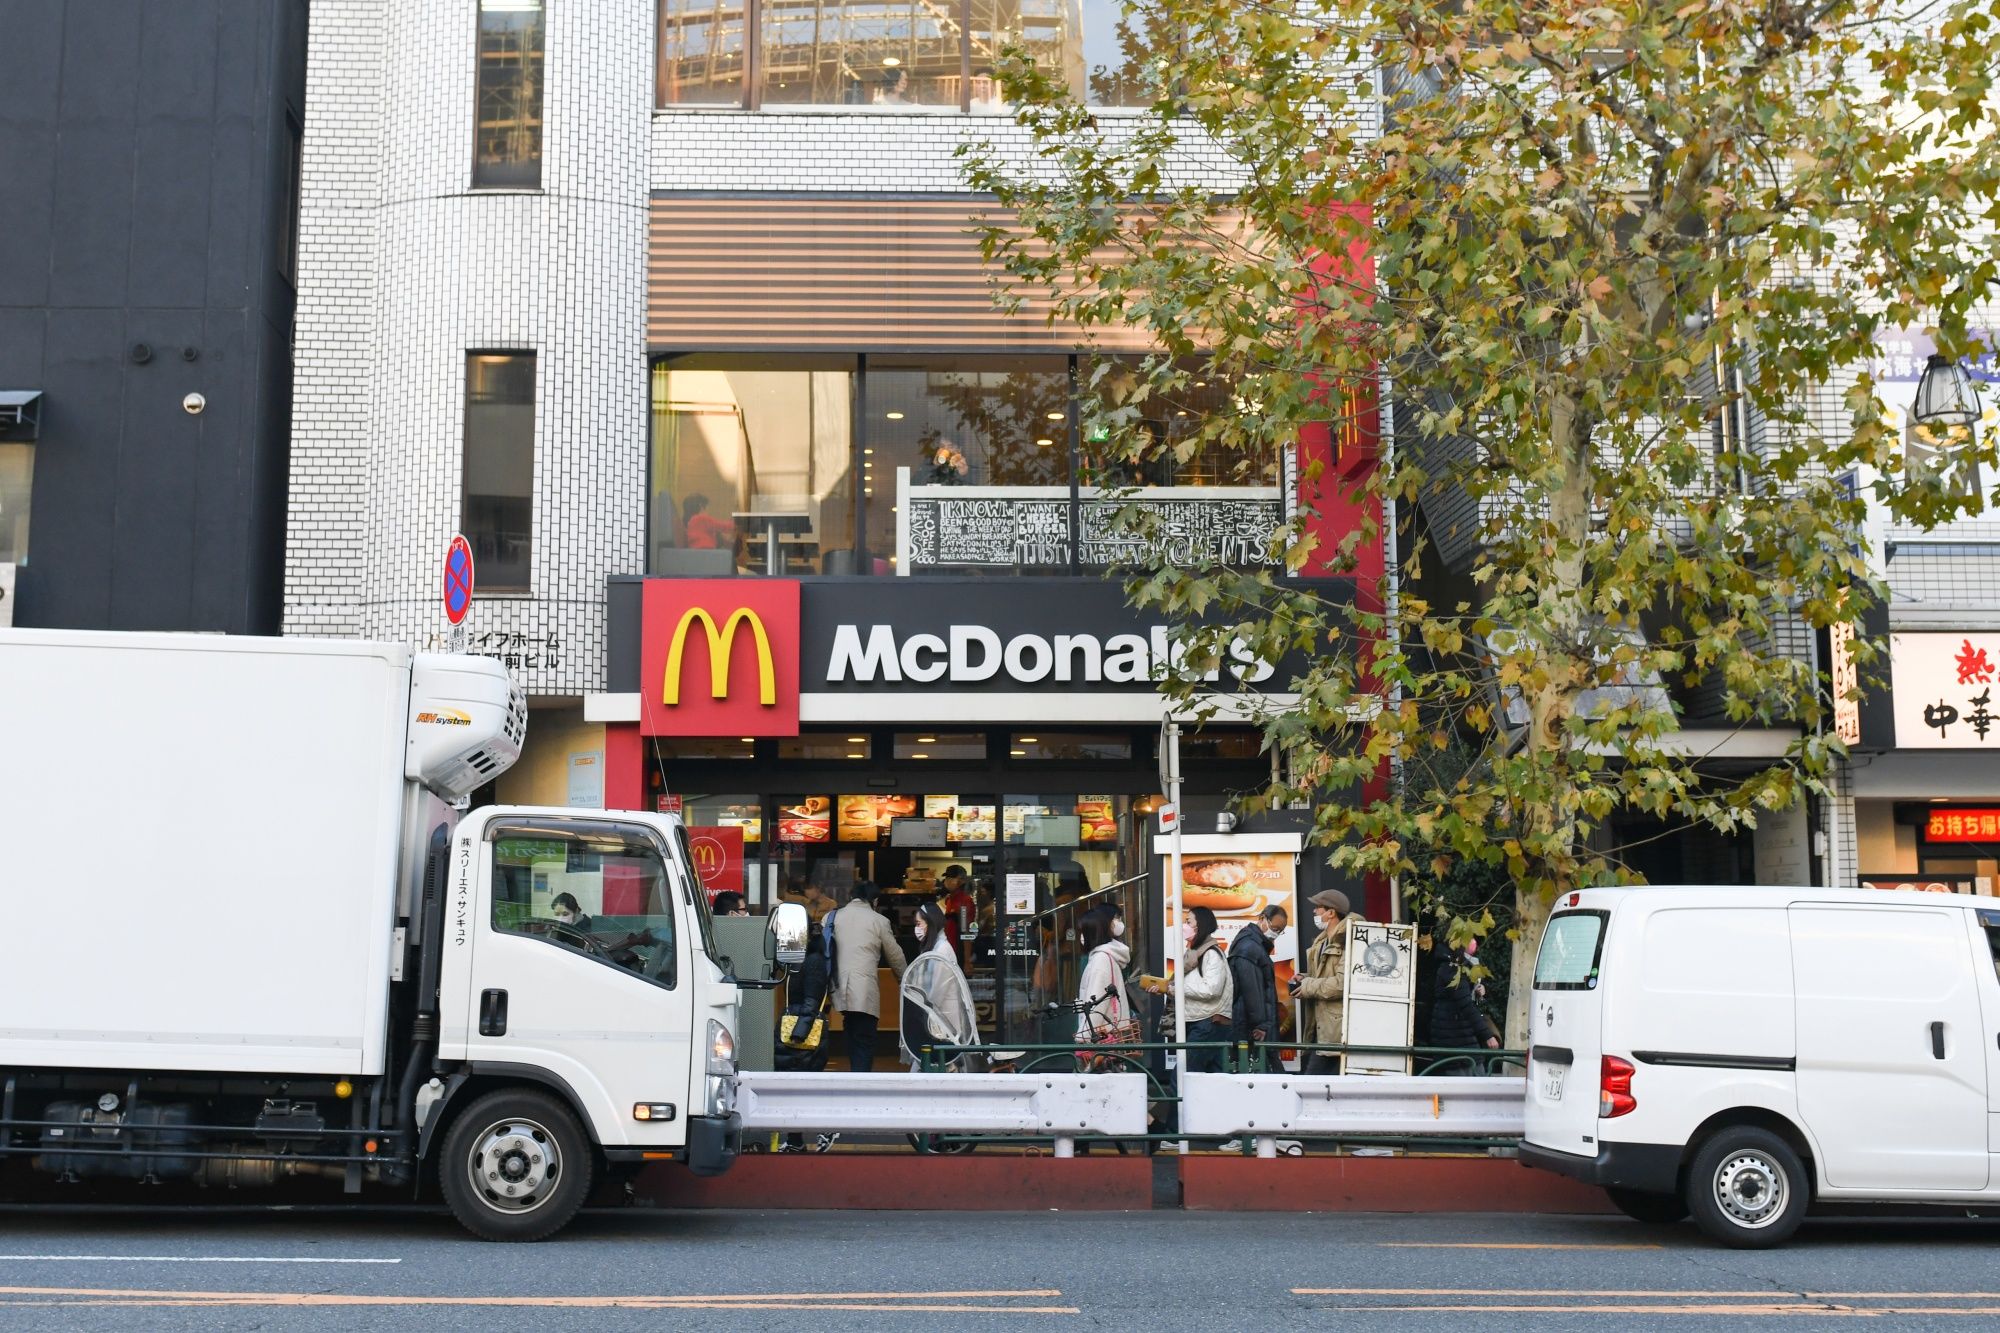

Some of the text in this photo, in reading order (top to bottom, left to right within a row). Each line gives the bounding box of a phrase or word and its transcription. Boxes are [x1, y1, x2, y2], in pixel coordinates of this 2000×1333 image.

[1028, 503, 1058, 513] WANT
[1059, 504, 1067, 514] A
[1018, 522, 1067, 535] BURGER
[1212, 508, 1225, 536] HAPPY
[1029, 543, 1063, 564] JUST
[1930, 814, 2000, 837] お持ち帰
